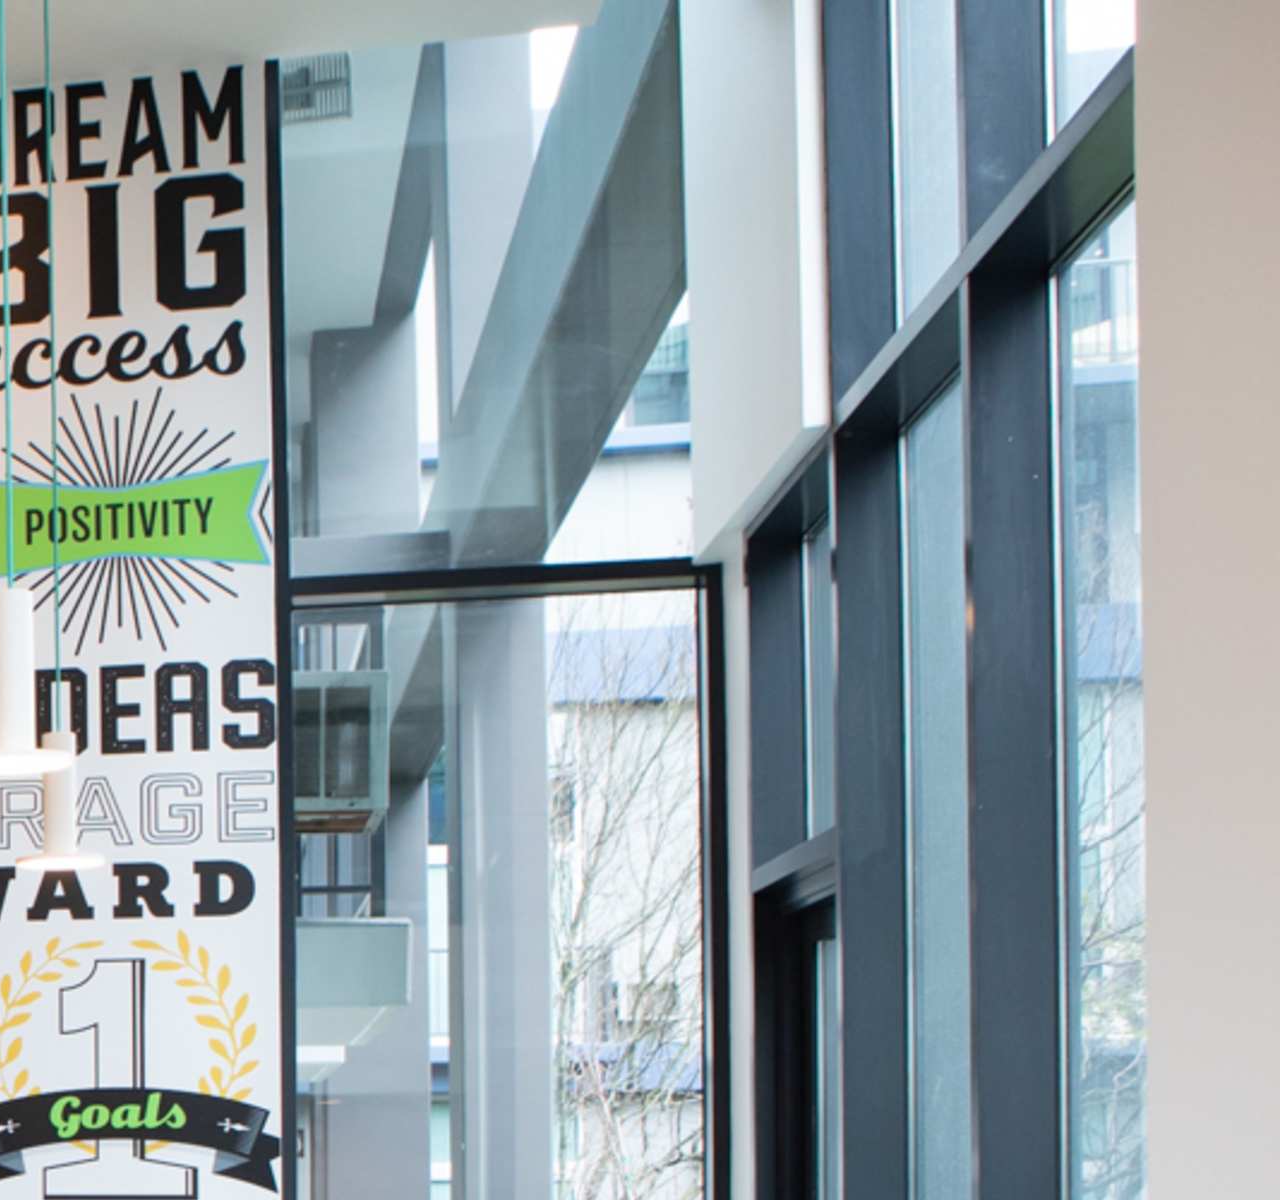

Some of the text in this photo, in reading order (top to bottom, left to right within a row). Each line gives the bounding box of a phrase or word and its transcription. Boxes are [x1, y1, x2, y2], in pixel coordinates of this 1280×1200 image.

[25, 497, 214, 546] POSITIVITY
[35, 658, 276, 758] DEAS
[49, 1092, 188, 1139] Goals
